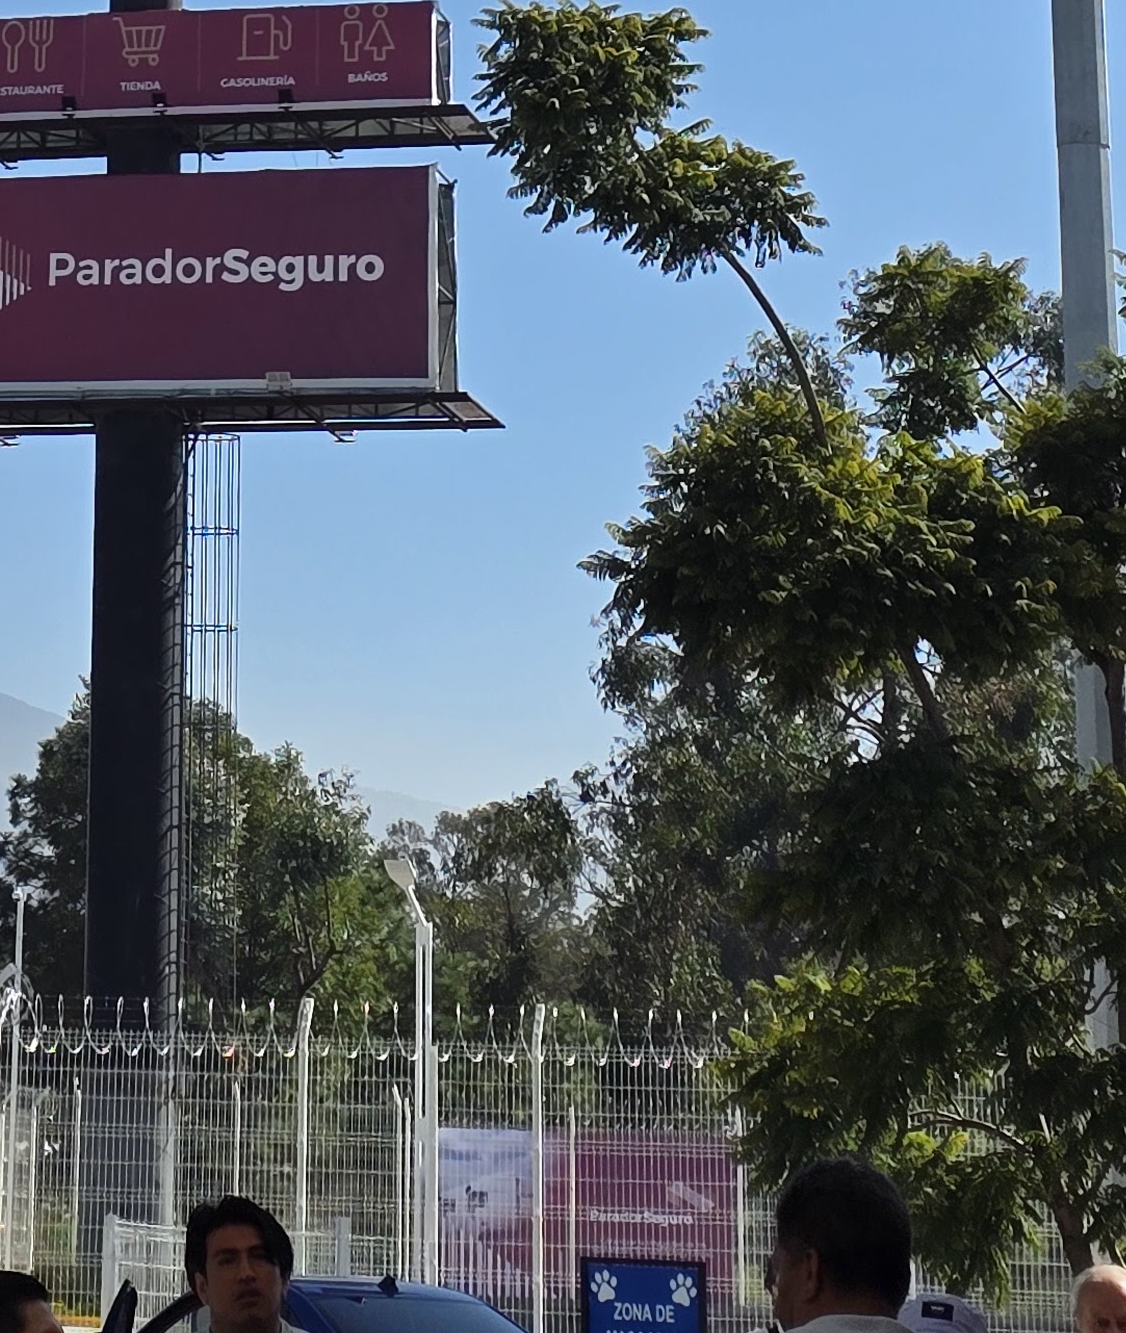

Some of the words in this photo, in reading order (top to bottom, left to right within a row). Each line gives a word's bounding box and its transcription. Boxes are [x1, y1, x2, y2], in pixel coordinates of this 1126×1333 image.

[220, 75, 295, 88] GASOLINERÍA
[347, 71, 388, 83] BAÑOS
[120, 80, 161, 91] TIENDA
[48, 248, 385, 292] ParadorSeguro
[613, 1301, 653, 1323] ZONA
[656, 1304, 675, 1324] DE
